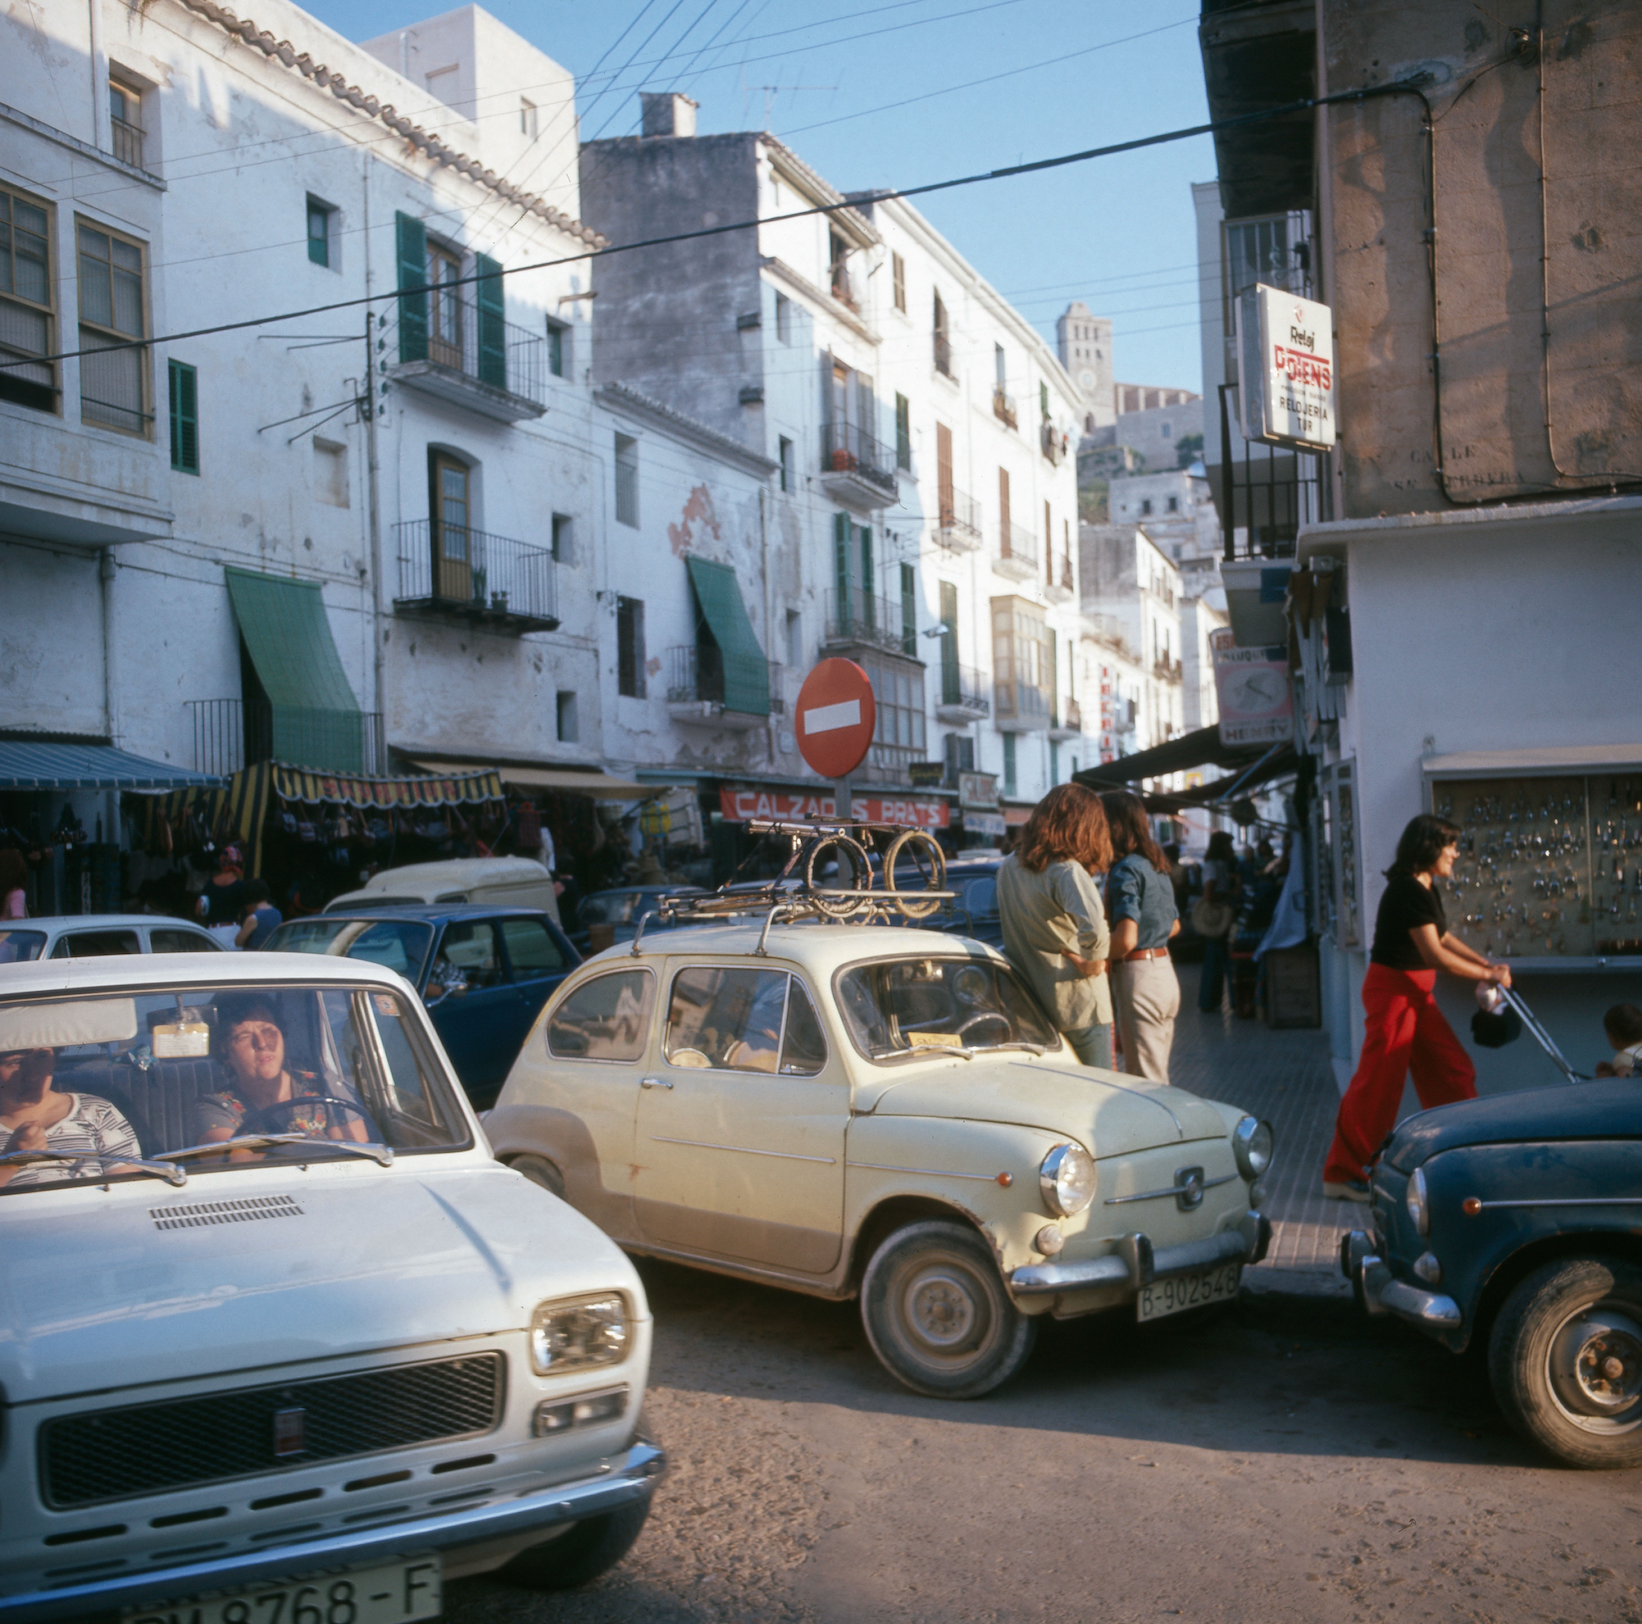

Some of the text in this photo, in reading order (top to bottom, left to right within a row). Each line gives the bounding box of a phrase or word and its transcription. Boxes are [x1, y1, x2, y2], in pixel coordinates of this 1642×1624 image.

[1290, 326, 1315, 353] Reloj
[1280, 397, 1328, 421] RELOJERIA
[1298, 417, 1313, 432] TUR
[736, 790, 868, 820] CALZADS
[881, 801, 941, 824] PRATS
